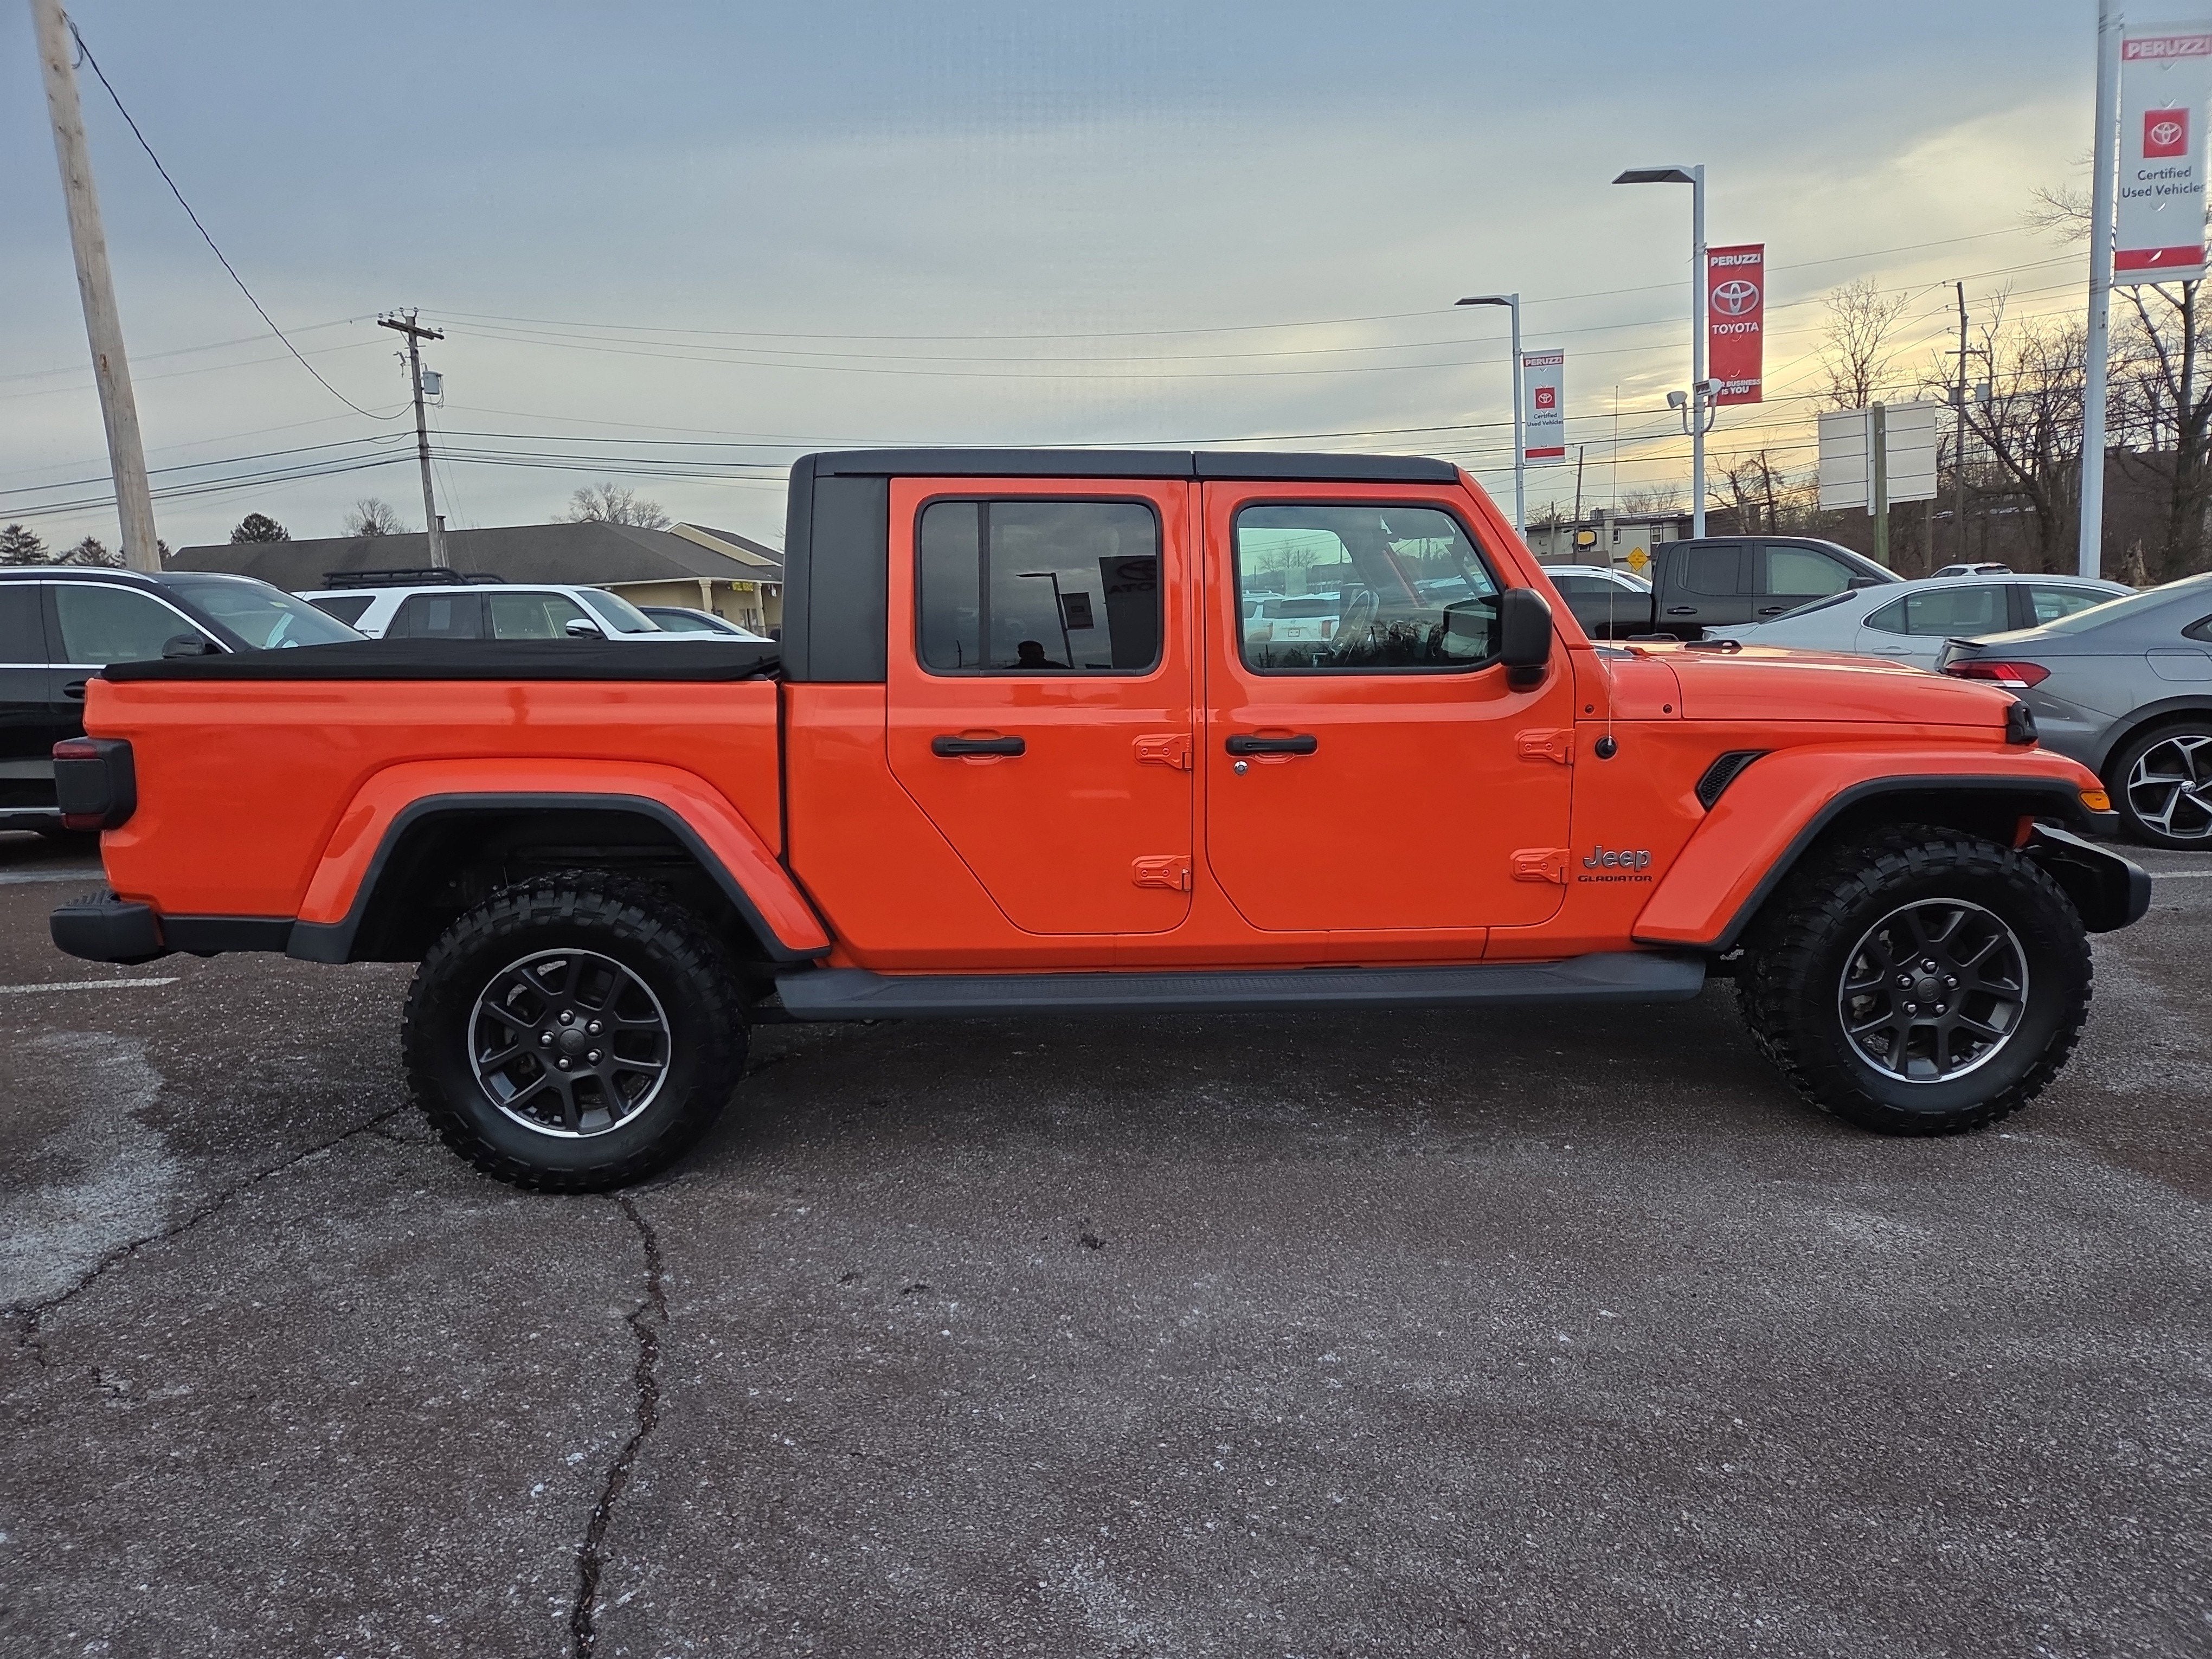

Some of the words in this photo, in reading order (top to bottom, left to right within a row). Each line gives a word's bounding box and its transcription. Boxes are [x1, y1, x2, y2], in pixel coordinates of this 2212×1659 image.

[2128, 37, 2210, 57] PERUZZI
[2138, 166, 2192, 181] Certified
[2122, 185, 2152, 198] Used
[1711, 253, 1760, 266] PERUZZI
[1712, 322, 1759, 335] TOYOTA
[1526, 357, 1561, 366] PERUZZI
[1726, 379, 1761, 387] BUSINESS
[1730, 385, 1750, 394] YOU
[1583, 845, 1651, 872] Jeep
